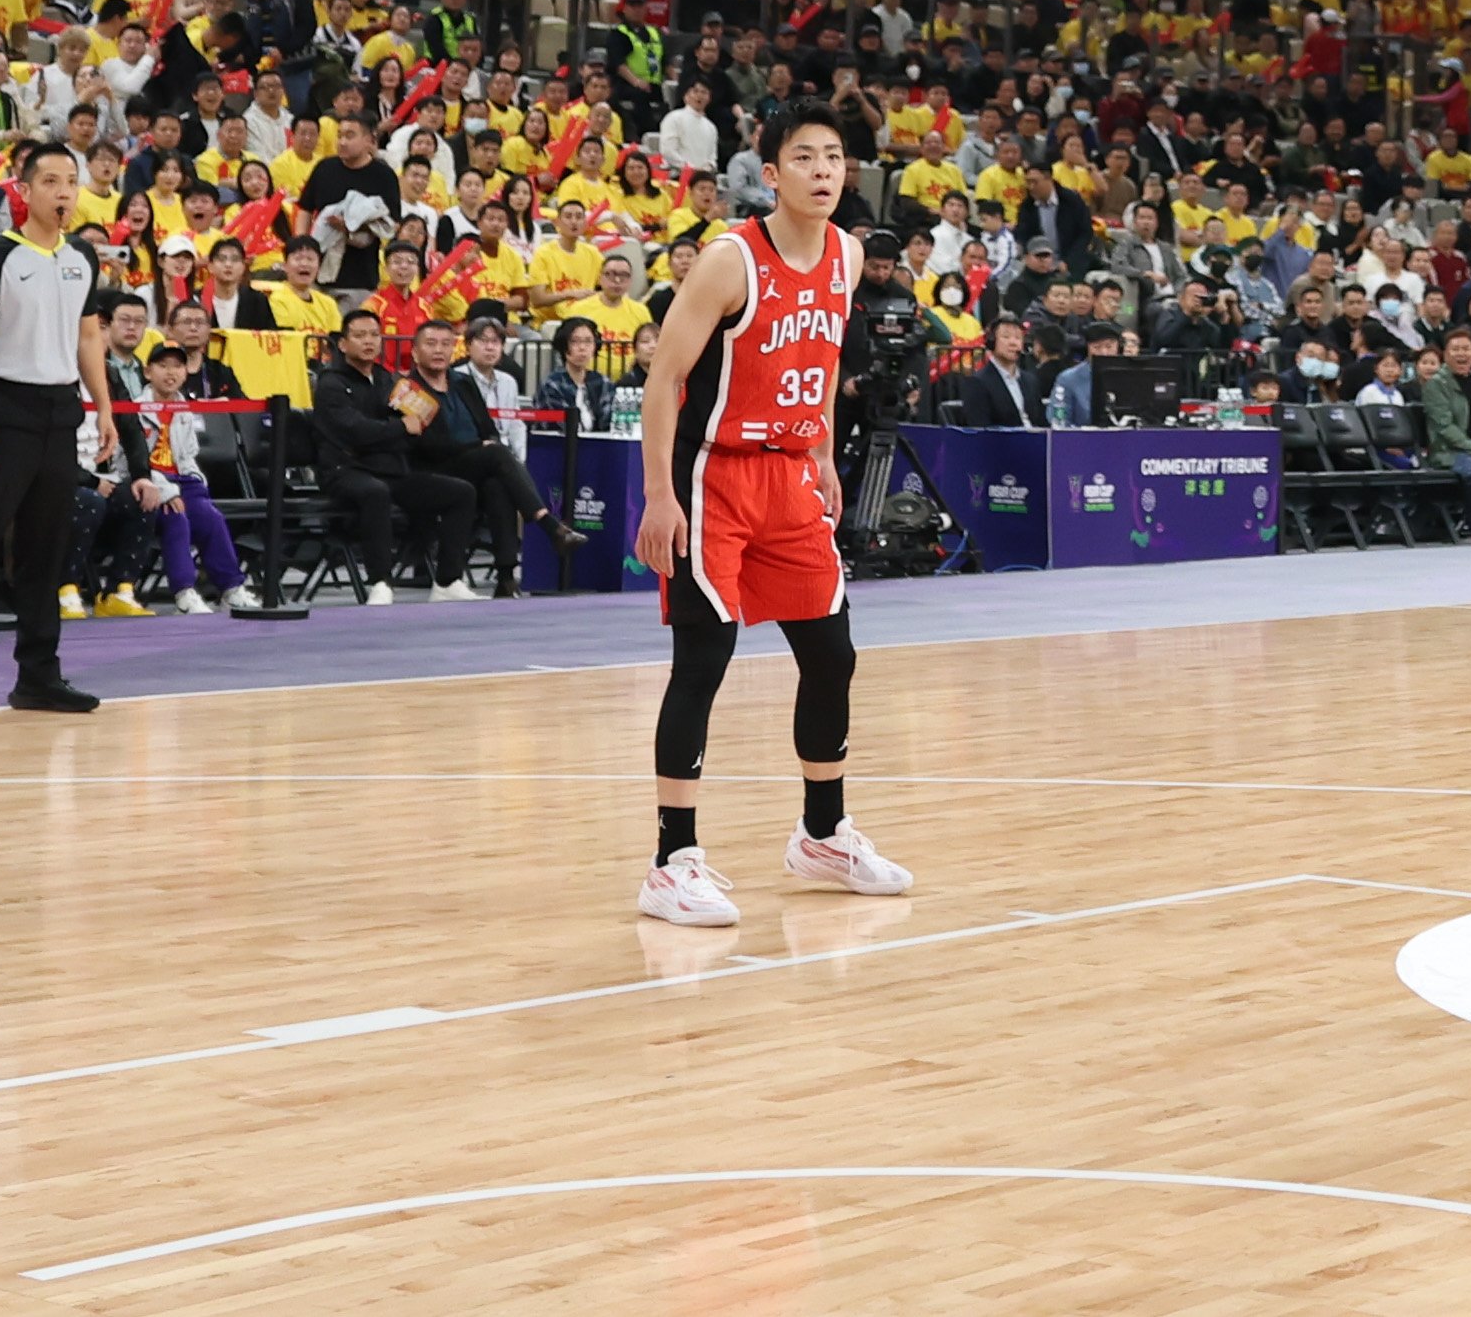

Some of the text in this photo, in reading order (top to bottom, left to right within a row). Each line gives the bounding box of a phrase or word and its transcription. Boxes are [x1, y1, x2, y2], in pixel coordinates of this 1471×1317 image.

[759, 308, 845, 355] JAPAN
[776, 366, 826, 408] 33
[1141, 457, 1269, 476] COMMENTARY TRIBUNE
